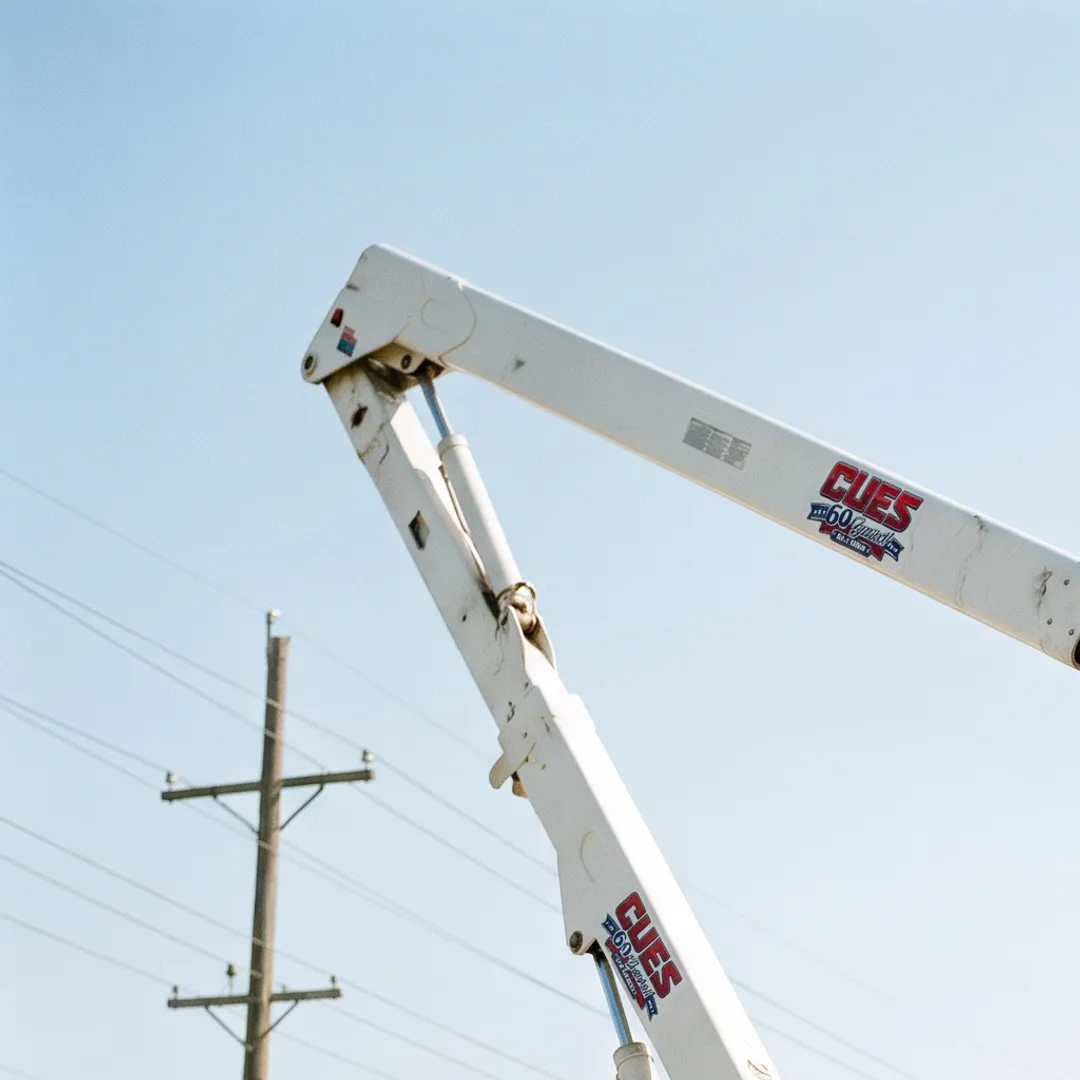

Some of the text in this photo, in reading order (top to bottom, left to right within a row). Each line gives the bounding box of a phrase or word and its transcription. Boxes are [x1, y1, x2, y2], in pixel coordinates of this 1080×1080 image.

[820, 461, 924, 532] CUES
[825, 504, 853, 528] 60
[613, 931, 632, 957] 60
[615, 891, 682, 999] CUES
